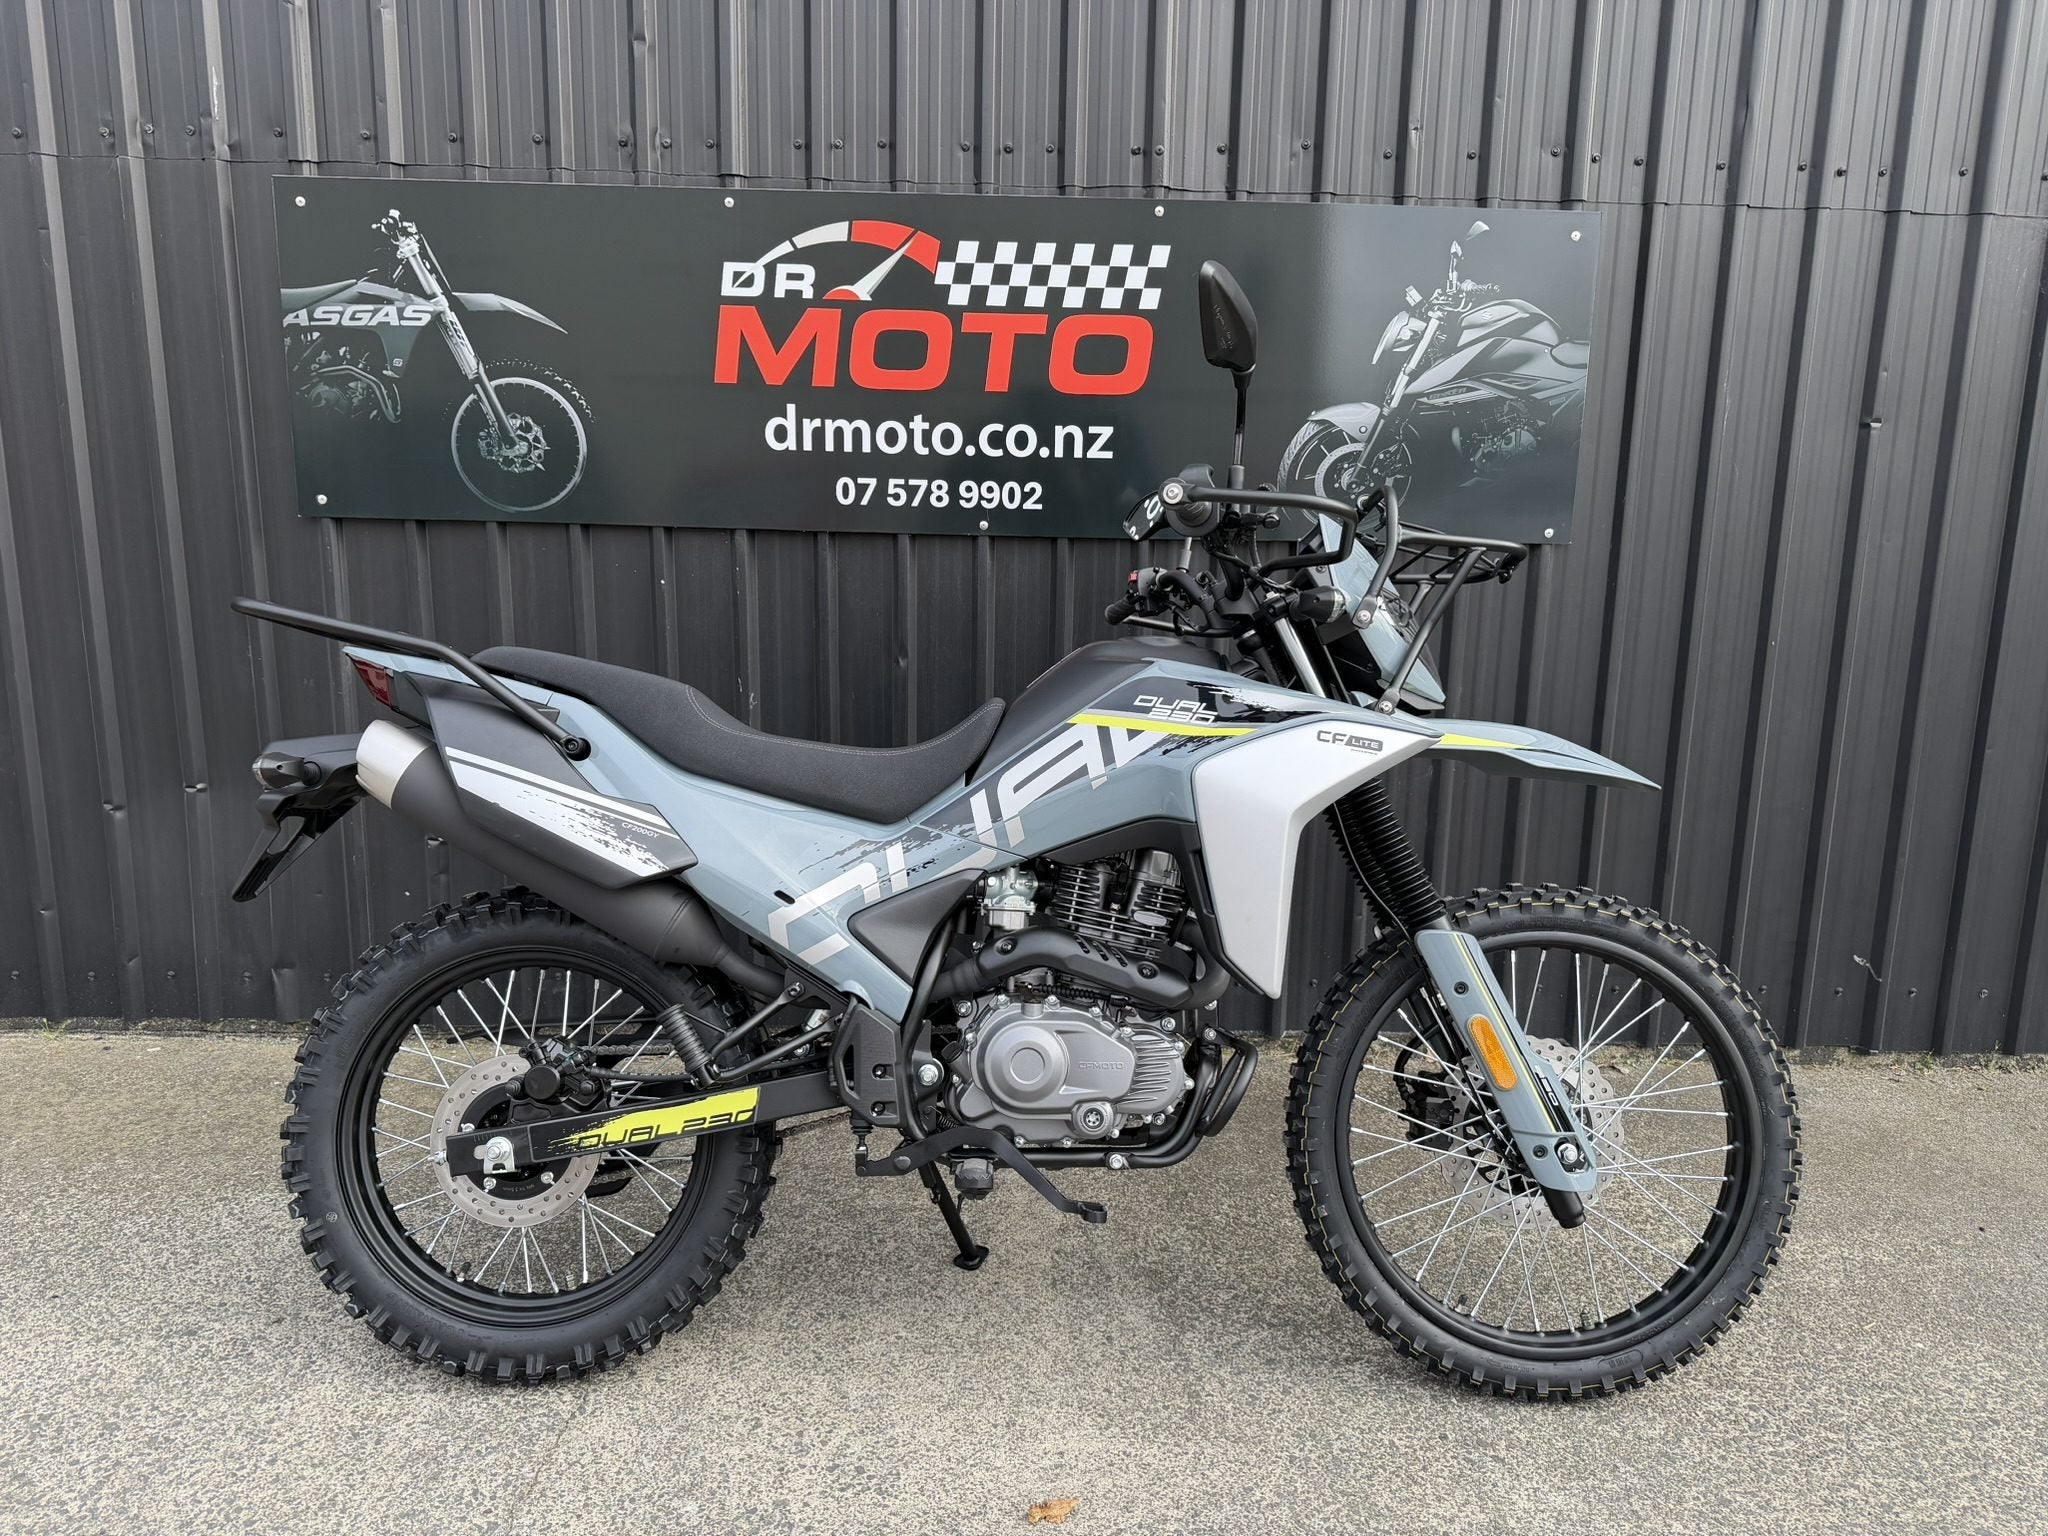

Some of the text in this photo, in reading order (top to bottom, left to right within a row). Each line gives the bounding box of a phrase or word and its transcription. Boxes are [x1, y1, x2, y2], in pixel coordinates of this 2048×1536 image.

[720, 261, 816, 299] DR
[714, 304, 1154, 395] MOTO
[764, 403, 1114, 459] drmoto.co.nz
[835, 476, 1043, 510] 07 578 9902
[1133, 694, 1218, 716] DUAL
[1147, 707, 1215, 725] 230
[621, 822, 660, 838] CF200GY
